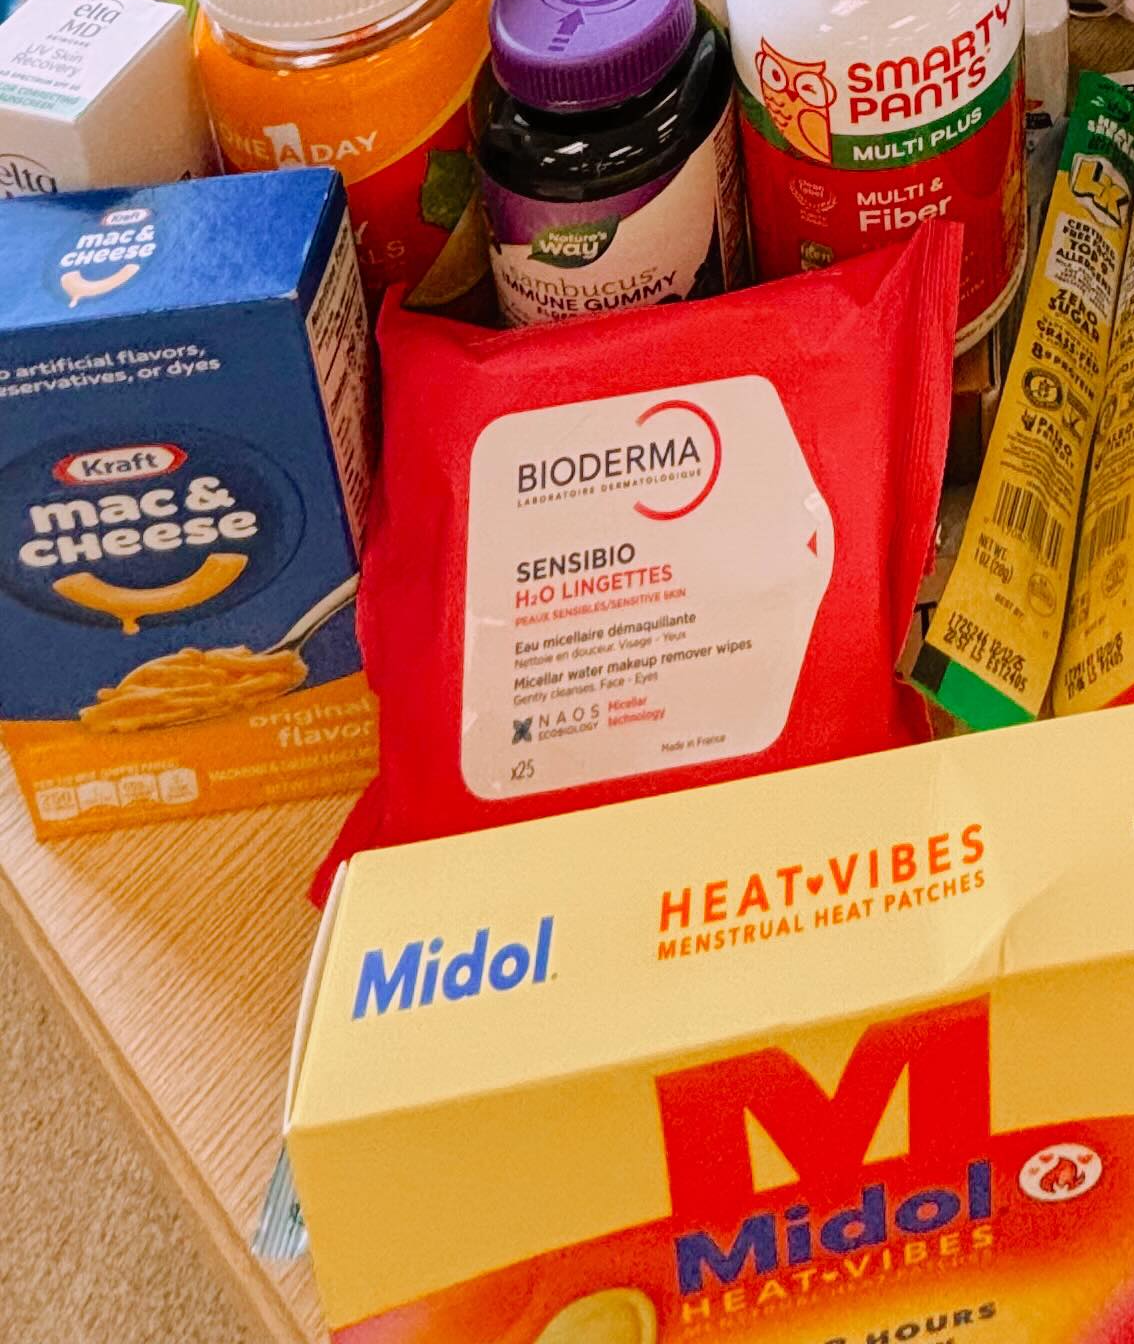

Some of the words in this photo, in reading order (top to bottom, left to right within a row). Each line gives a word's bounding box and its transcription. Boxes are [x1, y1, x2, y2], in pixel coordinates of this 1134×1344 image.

[58, 18, 101, 39] MD
[73, 1, 121, 25] elta
[10, 52, 82, 78] Recovery
[850, 54, 987, 125] PANTS
[309, 130, 378, 163] DAY
[852, 136, 924, 162] MULTI
[930, 105, 983, 148] PLUS
[856, 182, 925, 207] MULTI
[930, 176, 944, 193] &
[858, 194, 953, 233] Fiber
[77, 229, 132, 250] mac
[135, 224, 156, 242] &
[502, 271, 578, 312] IMMUNE
[583, 270, 677, 312] GUMMY
[1056, 288, 1099, 326] ZERO
[1048, 296, 1101, 344] SUGAR
[16, 352, 111, 378] artificial
[116, 344, 206, 370] flavors,
[136, 364, 161, 380] or
[167, 358, 221, 377] dyes
[82, 453, 158, 477] Kraft
[517, 436, 701, 494] BIODERMA
[29, 488, 178, 534] mac
[185, 476, 236, 512] &
[516, 485, 596, 508] LABORATOIRE
[600, 467, 702, 493] DERMATOLOGIQUE
[516, 542, 636, 584] SENSIBIO
[562, 564, 674, 600] LINGETTES
[515, 640, 540, 656] Eau
[543, 626, 604, 650] micellaire
[607, 612, 697, 639] démaquillante
[513, 670, 564, 692] Micellar
[567, 666, 604, 681] water
[606, 654, 658, 674] makeup
[660, 647, 712, 665] remover
[716, 637, 753, 655] wipes
[513, 690, 548, 707] Gently
[599, 678, 626, 690] Face
[634, 671, 659, 686] Eyes
[249, 698, 371, 729] original
[277, 720, 375, 749] flavor
[696, 733, 727, 748] France
[510, 758, 535, 781] x25
[828, 822, 985, 896] VIBES
[656, 916, 805, 962] MENSTRUAL
[814, 898, 875, 929] HEAT
[883, 869, 986, 913] PATCHES
[351, 915, 554, 1022] Midol
[674, 1158, 994, 1297] Midol
[865, 1300, 998, 1344] HOURS
